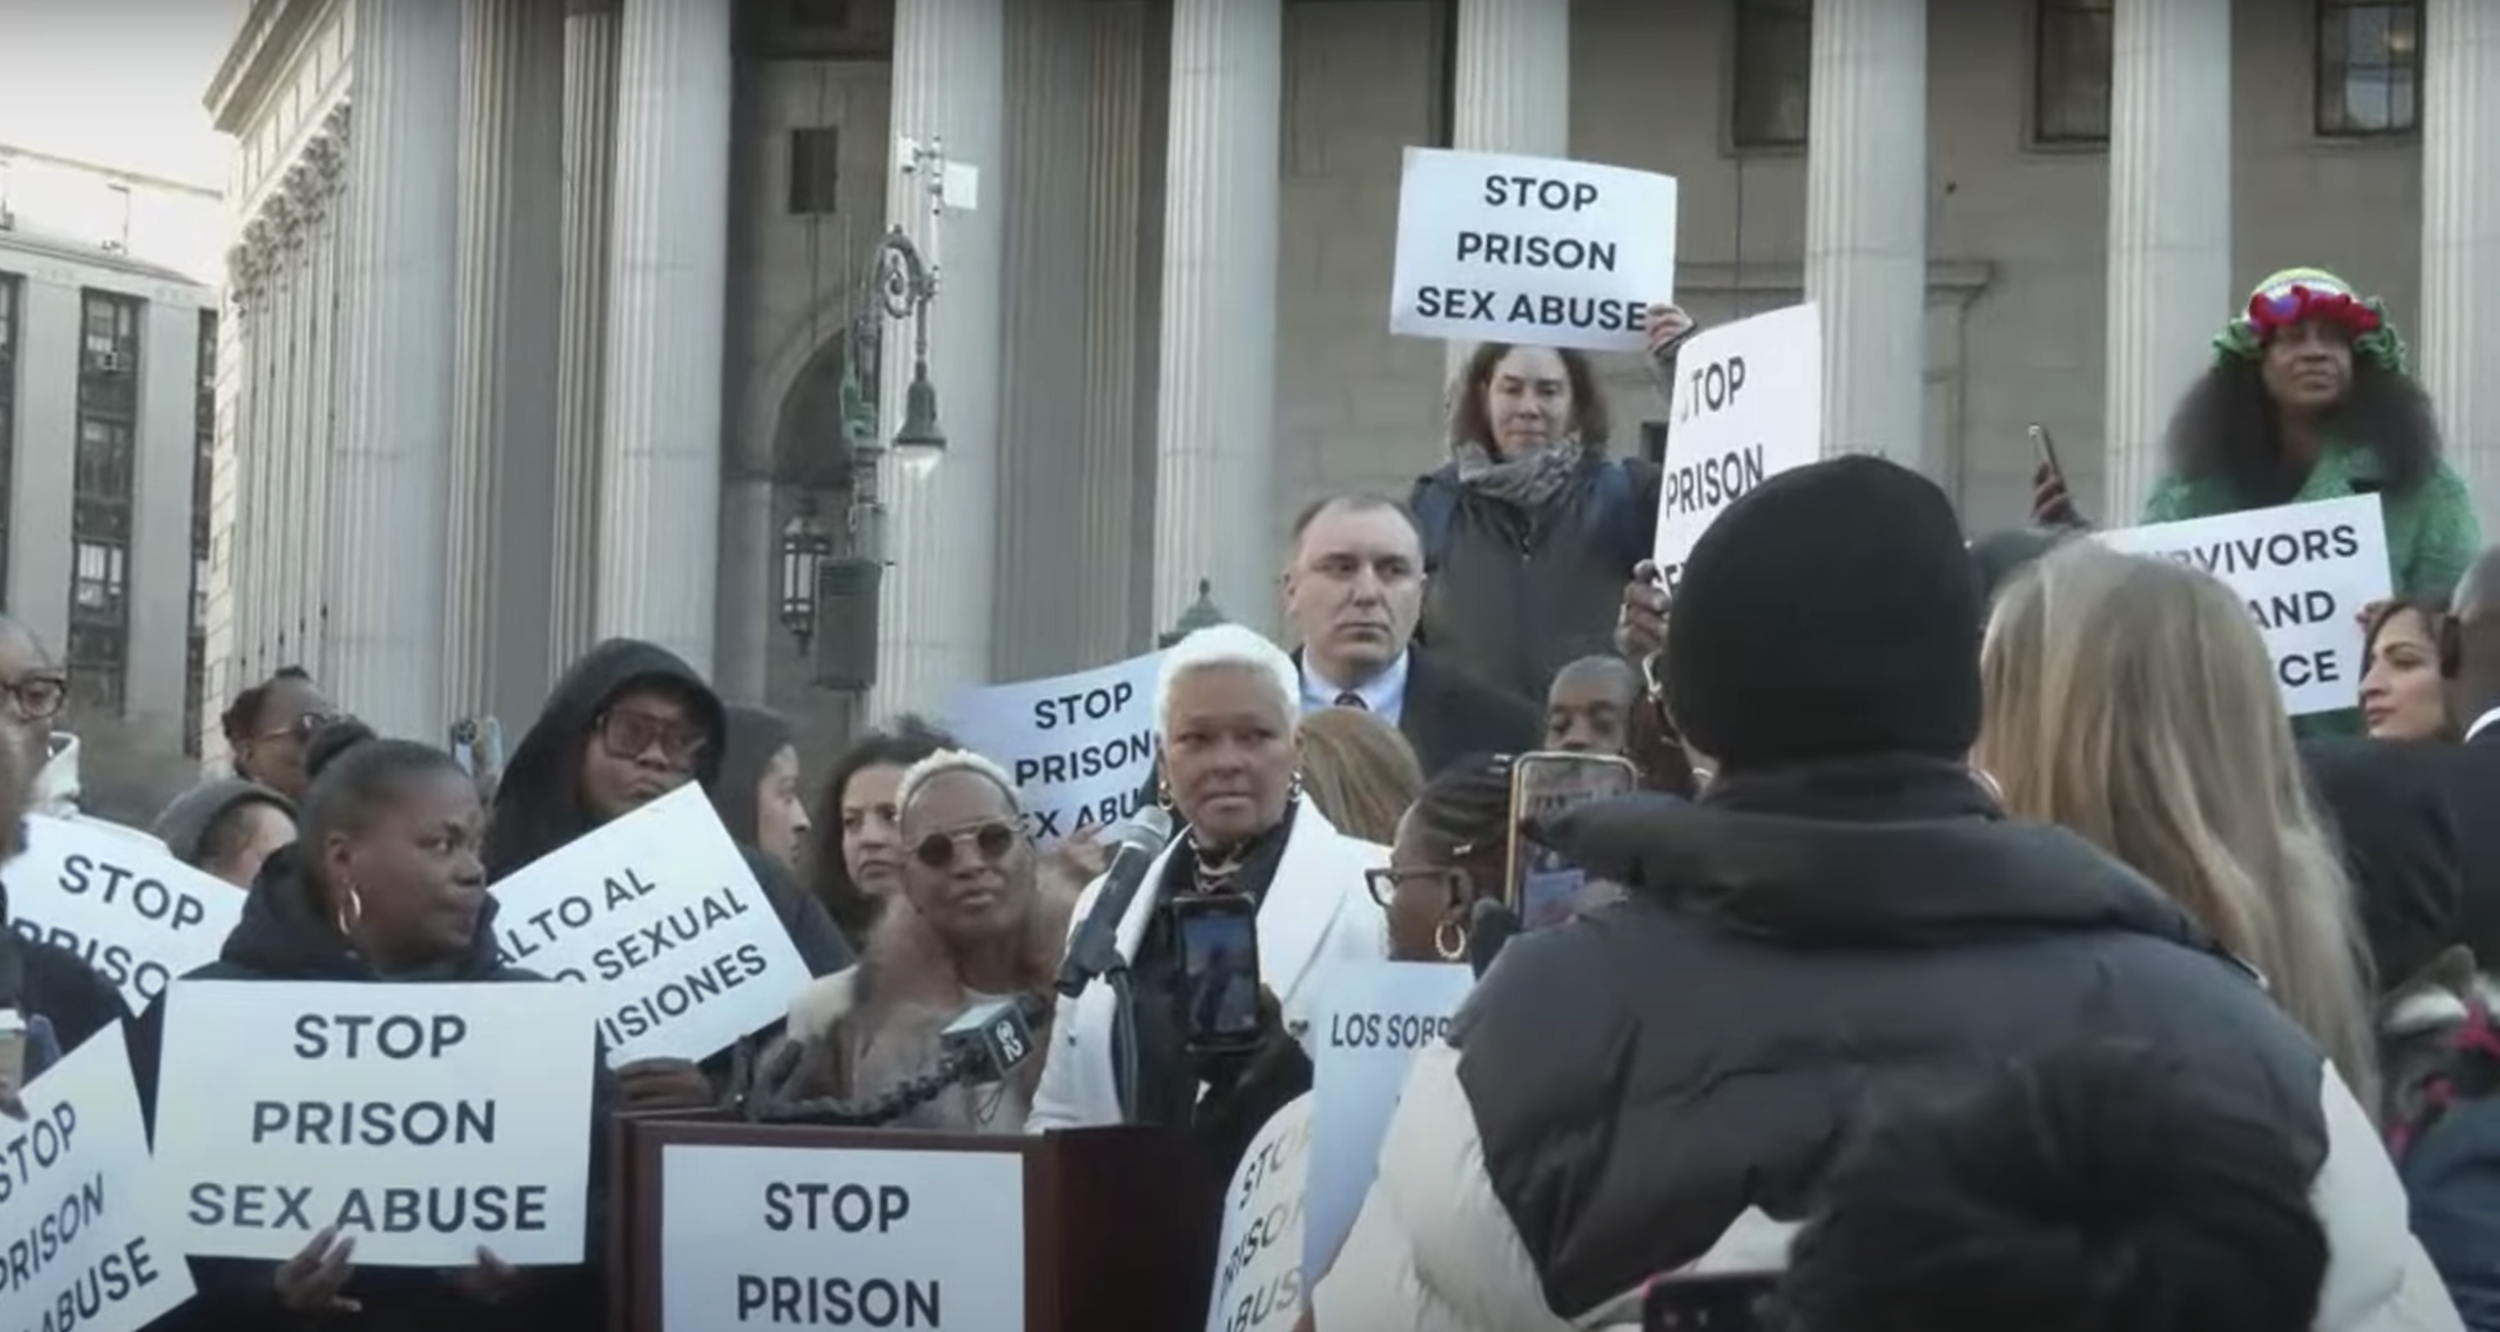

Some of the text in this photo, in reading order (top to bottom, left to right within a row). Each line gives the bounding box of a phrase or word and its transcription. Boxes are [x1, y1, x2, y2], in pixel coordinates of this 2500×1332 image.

[1484, 174, 1598, 213] STOP
[1456, 231, 1617, 272] PRISON
[1416, 286, 1648, 333] SEX ABUSE
[1666, 443, 1763, 520] PRISON
[1034, 681, 1133, 729] STOP
[1014, 730, 1151, 788] PRISON
[1073, 788, 1138, 836] ABU
[58, 853, 205, 931] STOP
[496, 868, 656, 967] ALTO AL
[593, 886, 749, 982] SEXUAL
[603, 943, 767, 1046] ISIONES
[294, 1014, 467, 1060] STOP
[1331, 1013, 1381, 1049] LOS
[251, 1099, 496, 1145] PRISON
[187, 1183, 547, 1233] SEX ABUSE
[764, 1181, 911, 1233] STOP
[737, 1275, 940, 1330] PRISON
